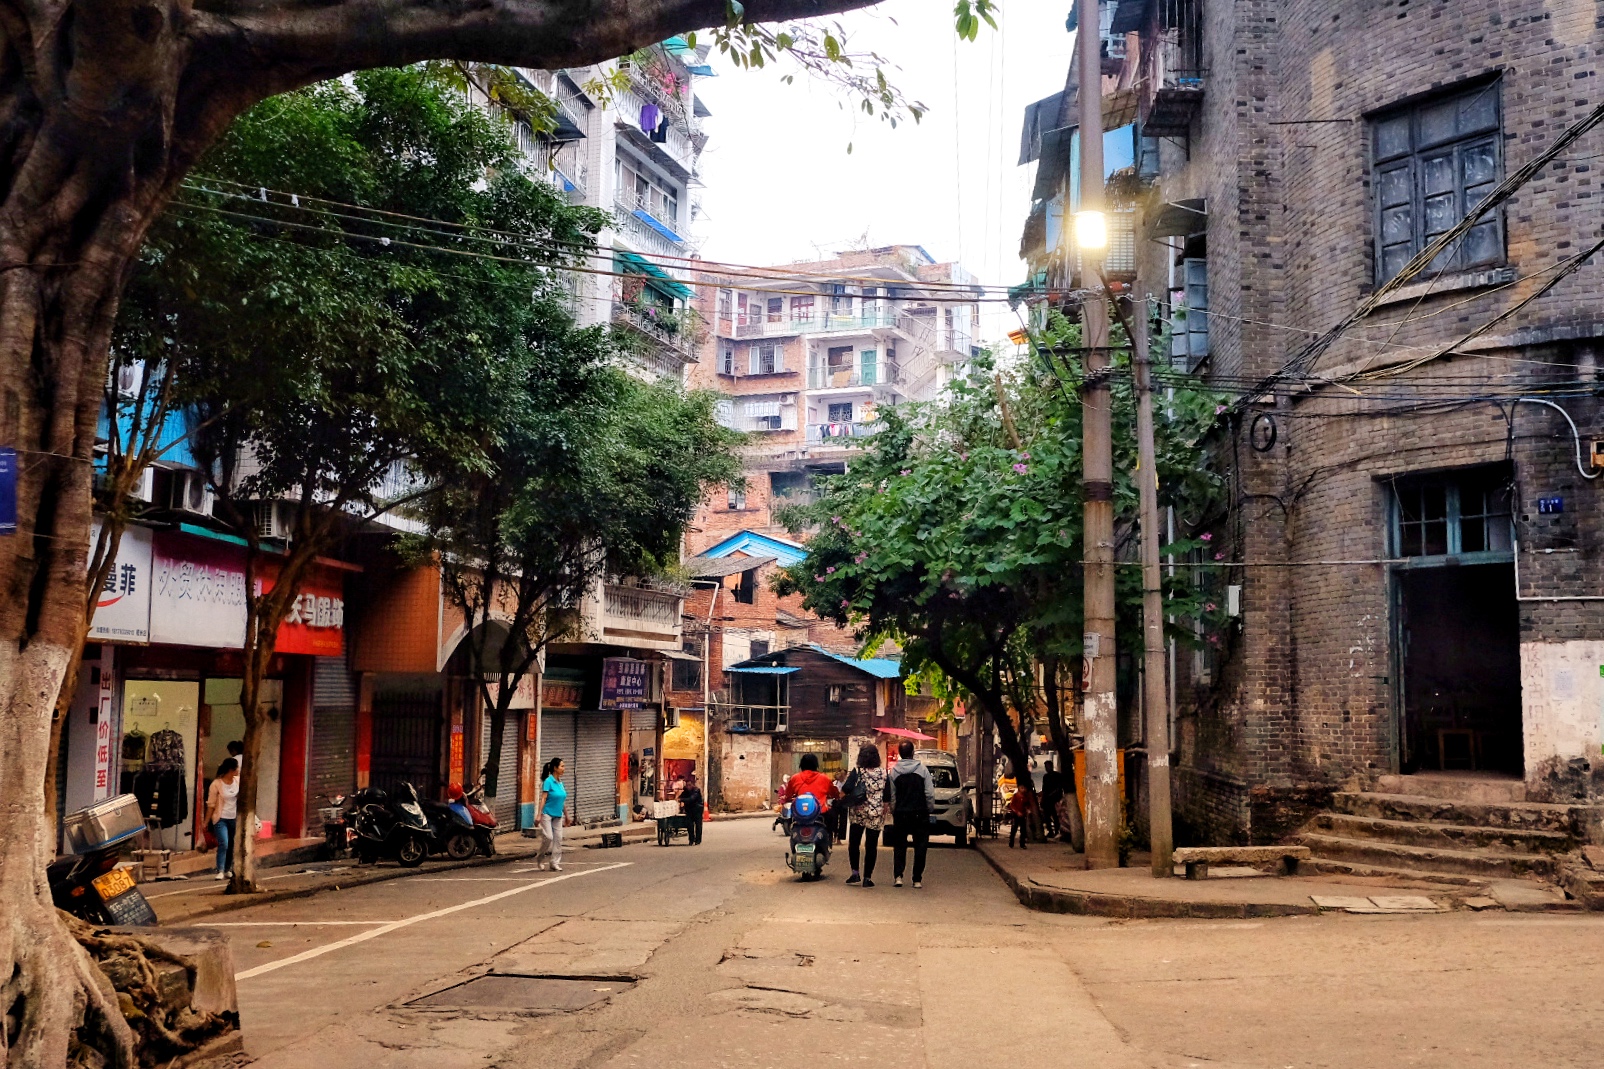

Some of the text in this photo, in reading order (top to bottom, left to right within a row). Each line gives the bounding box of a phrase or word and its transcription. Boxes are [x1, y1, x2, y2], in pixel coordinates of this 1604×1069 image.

[96, 671, 111, 802] 出厂价低至
